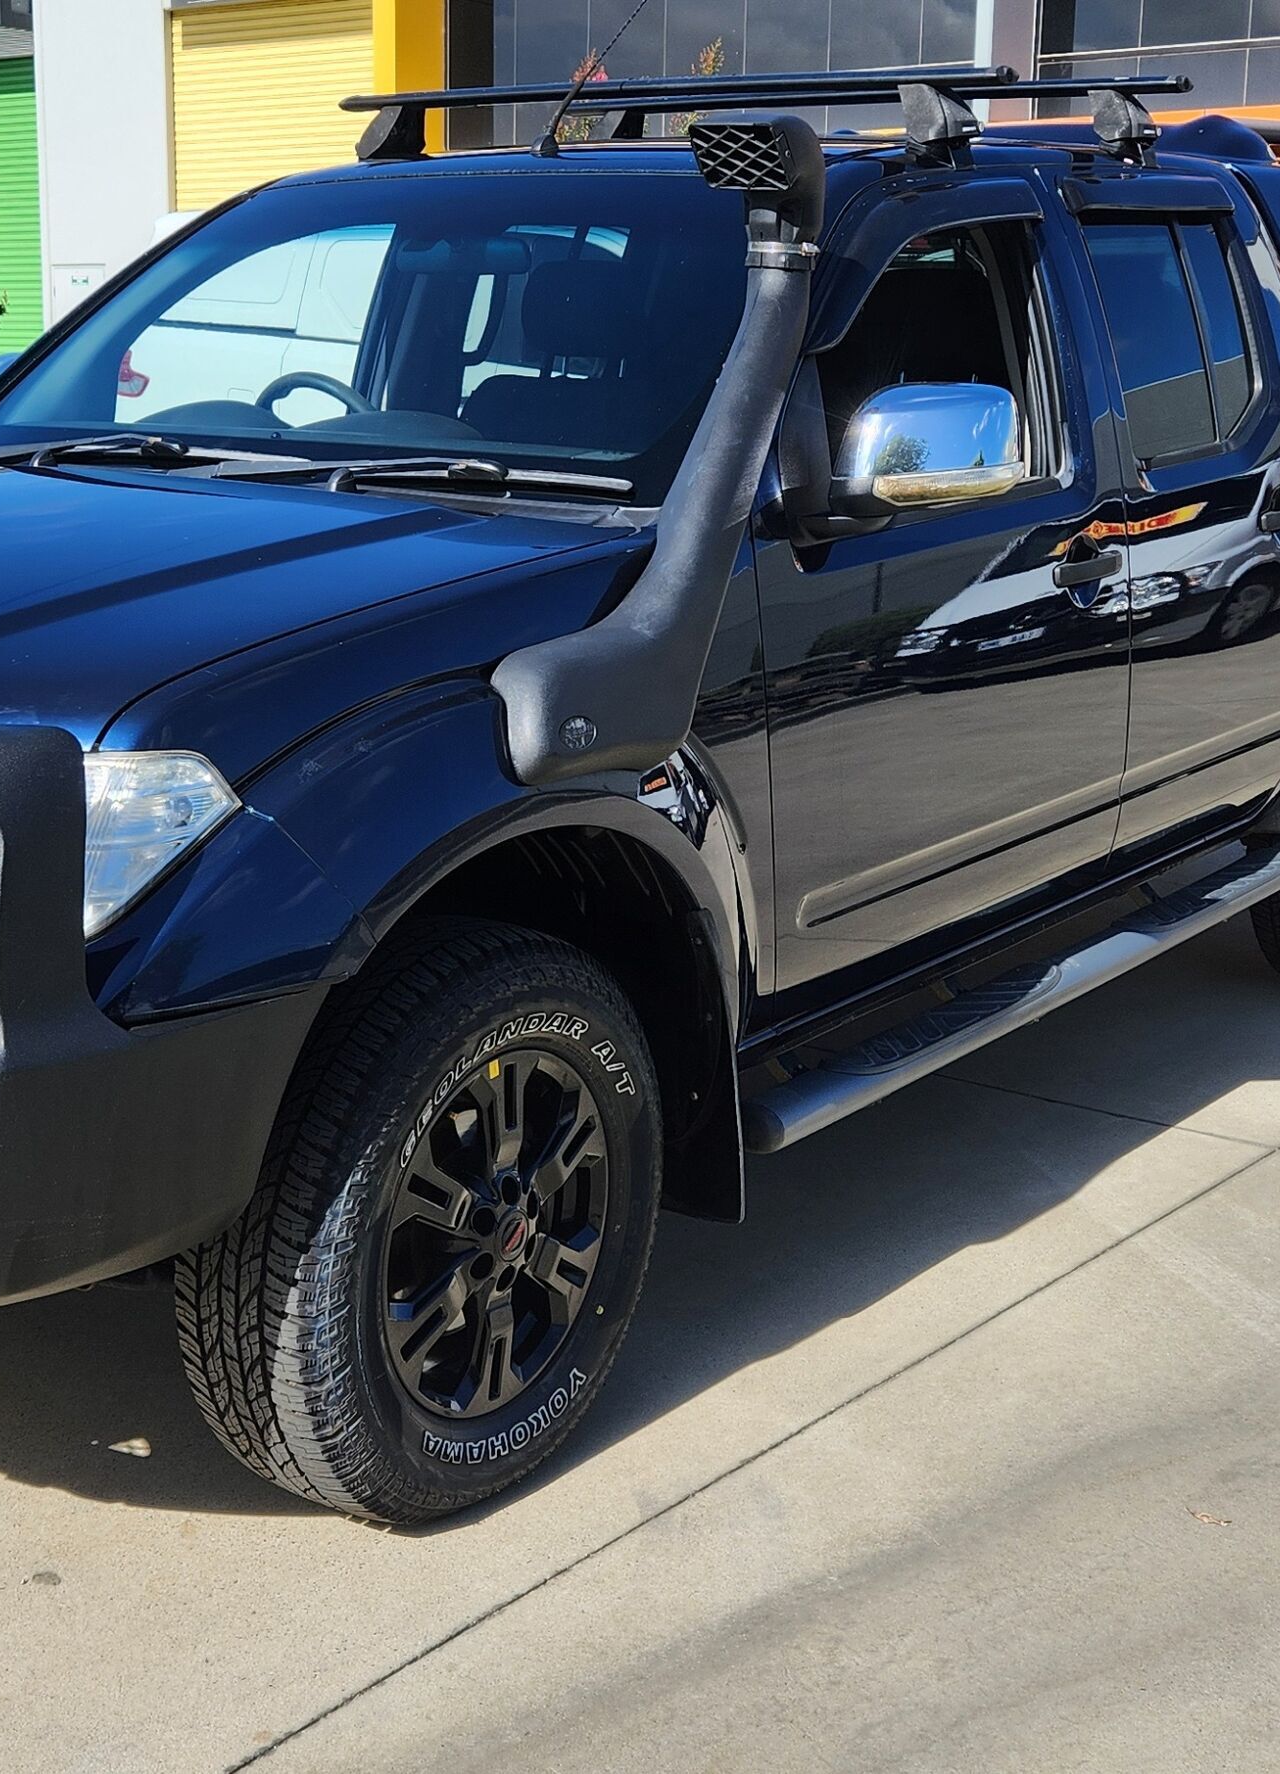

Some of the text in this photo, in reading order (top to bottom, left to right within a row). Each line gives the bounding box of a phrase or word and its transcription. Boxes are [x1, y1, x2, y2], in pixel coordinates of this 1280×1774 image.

[401, 1012, 636, 1168] GEOLANDAR A/T
[422, 1367, 588, 1465] YOKOHAMA
